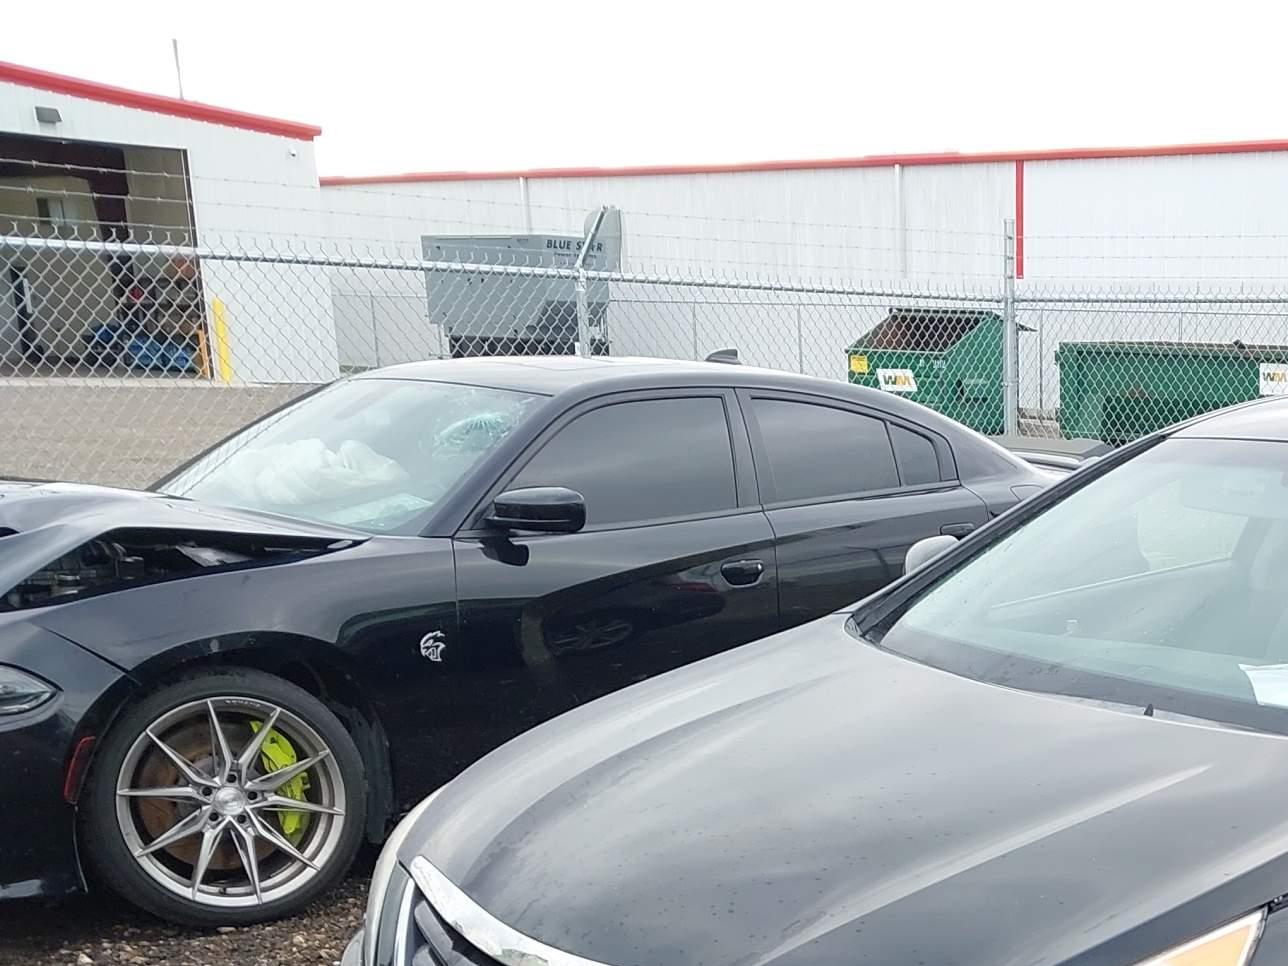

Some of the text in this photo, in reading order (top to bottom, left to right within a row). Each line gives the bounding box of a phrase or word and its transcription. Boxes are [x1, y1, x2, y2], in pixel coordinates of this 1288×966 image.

[546, 239, 604, 252] BLUE SR
[882, 374, 912, 386] WM
[1262, 371, 1287, 383] WM
